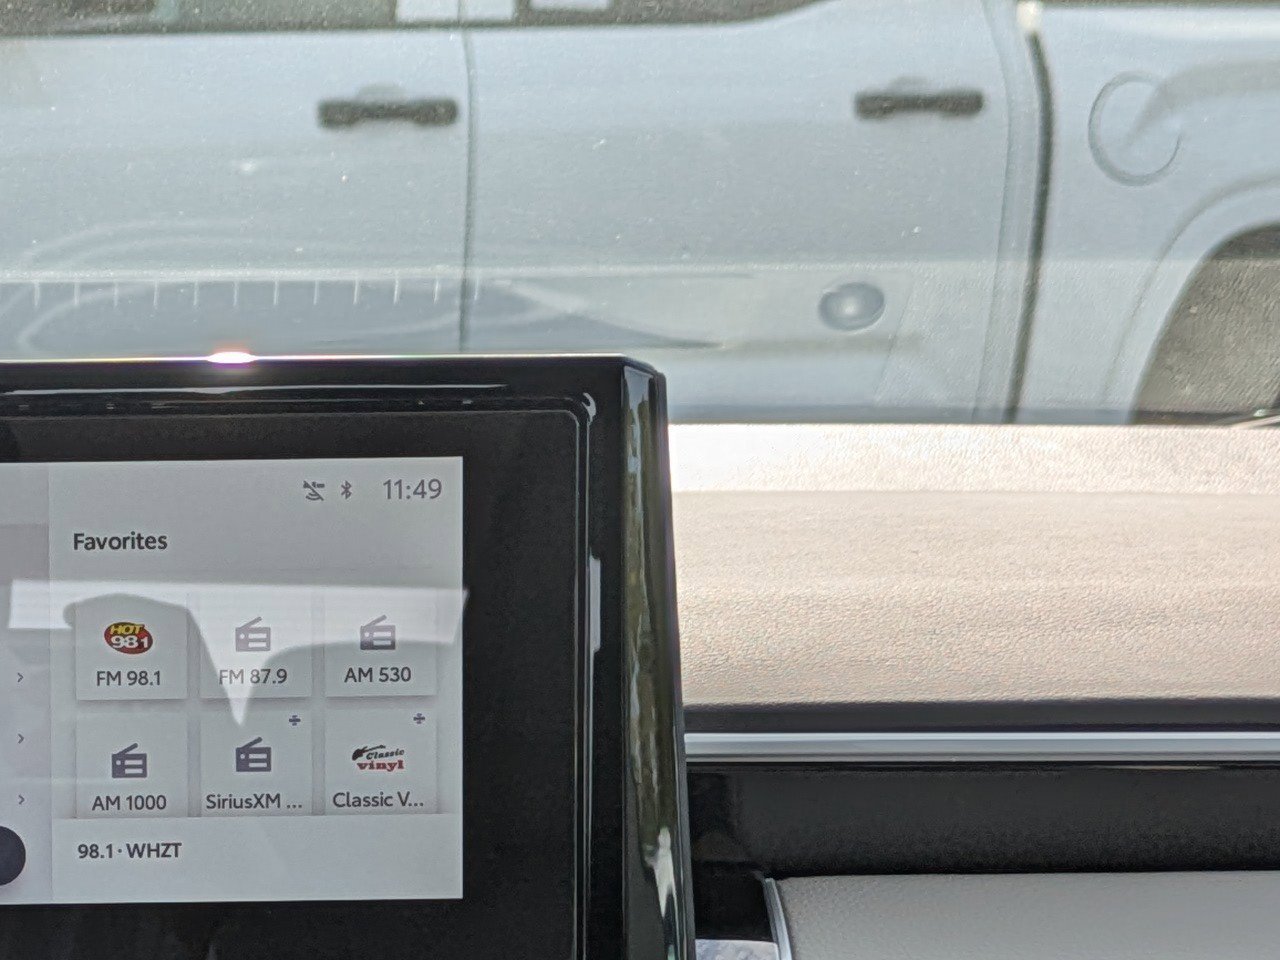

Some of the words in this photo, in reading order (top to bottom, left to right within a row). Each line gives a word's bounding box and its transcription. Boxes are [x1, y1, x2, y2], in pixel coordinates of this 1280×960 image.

[383, 478, 442, 500] 11:49
[73, 532, 168, 551] Favorites
[110, 624, 144, 635] HOT
[96, 671, 122, 686] FM
[126, 670, 161, 686] 98.1
[219, 670, 245, 685] FM
[249, 669, 288, 685] 87.9
[344, 668, 374, 683] AM
[378, 667, 412, 683] 530
[365, 748, 405, 761] Classic
[357, 759, 404, 772] vinyl
[92, 796, 121, 811] AM
[126, 795, 167, 811] 1000
[206, 794, 281, 809] SiriusXM
[333, 792, 393, 808] Classic
[126, 843, 182, 858] WHZT
